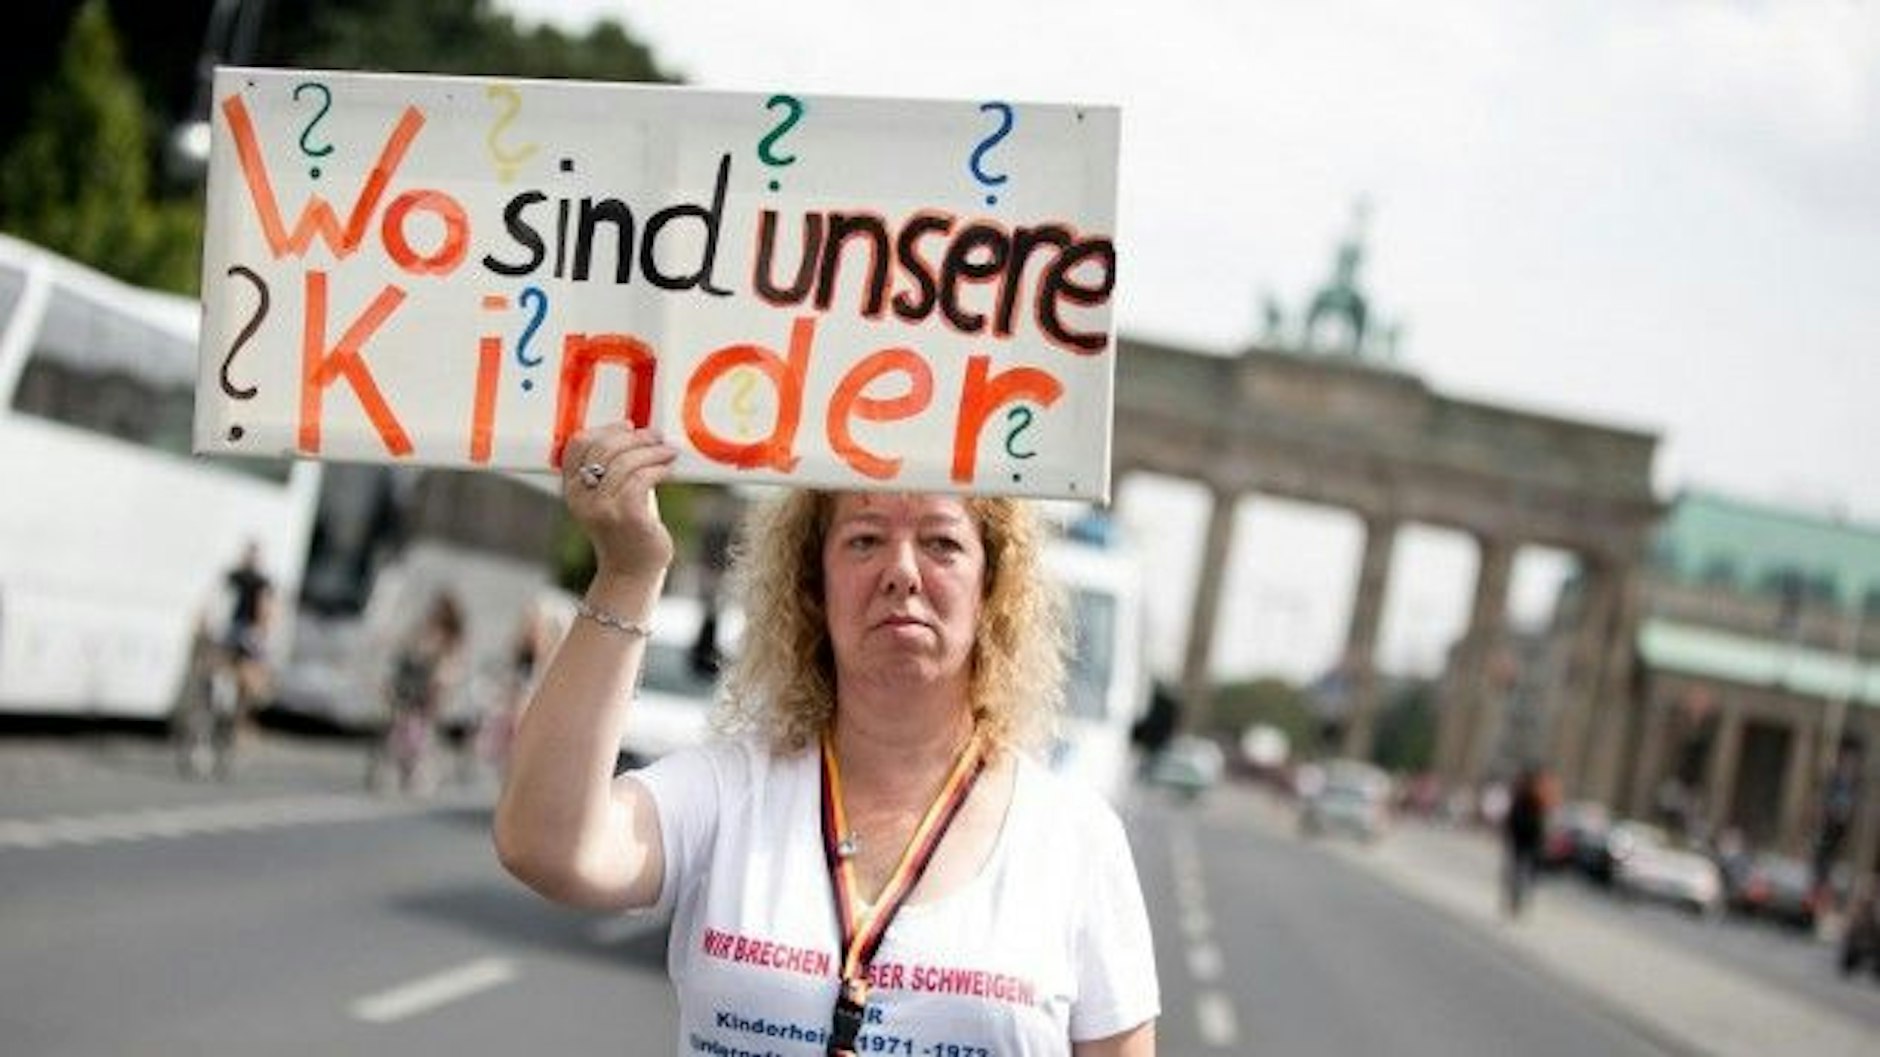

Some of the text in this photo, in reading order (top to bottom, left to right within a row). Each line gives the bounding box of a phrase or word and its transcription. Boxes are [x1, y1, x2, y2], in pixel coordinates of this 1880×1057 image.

[221, 94, 1117, 356] Wo sind unsere
[298, 270, 1064, 485] Kinder
[704, 928, 734, 959] WIR
[733, 935, 832, 977] BRECHEN
[867, 963, 904, 989] SER
[716, 1012, 826, 1045] Kinderhei
[859, 1035, 913, 1055] 1971
